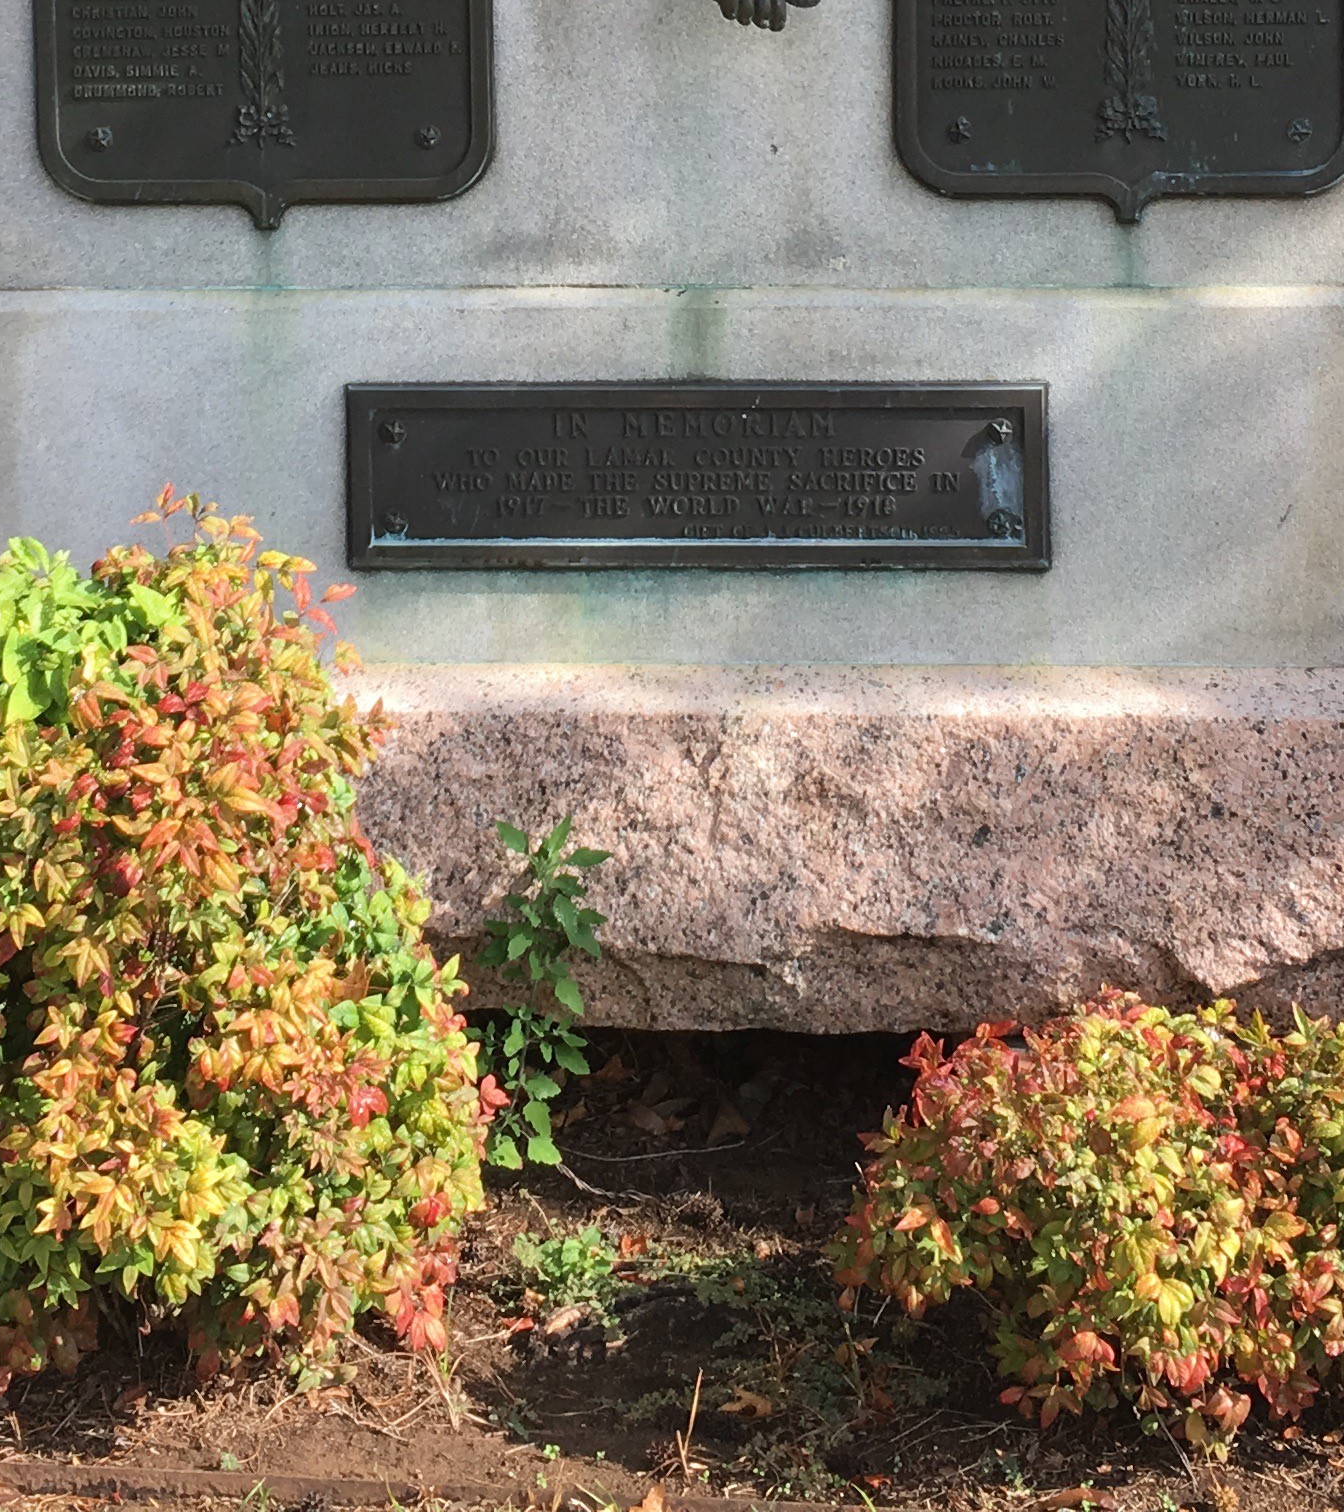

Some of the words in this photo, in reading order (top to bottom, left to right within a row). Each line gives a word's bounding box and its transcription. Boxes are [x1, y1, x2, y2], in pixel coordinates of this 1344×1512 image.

[1245, 11, 1307, 24] HERMAN
[73, 65, 119, 78] DAVIS,
[126, 65, 179, 77] SIMMIE
[168, 84, 223, 97] ROBERT
[554, 413, 588, 438] IN
[622, 411, 836, 438] MEMORIAM
[467, 447, 500, 466] TO
[517, 447, 569, 466] OUR
[586, 447, 675, 466] LAMAR
[694, 446, 803, 467] COUNTY
[820, 446, 925, 467] HEROES
[434, 472, 493, 491] WHO
[506, 472, 576, 491] MADE
[590, 472, 638, 491] THE
[653, 471, 773, 491] SUPREME
[788, 470, 918, 492] SACRIFICE
[929, 471, 961, 491] IN
[580, 495, 630, 517] THE
[647, 495, 740, 516] WORLD
[845, 495, 897, 516] 1918
